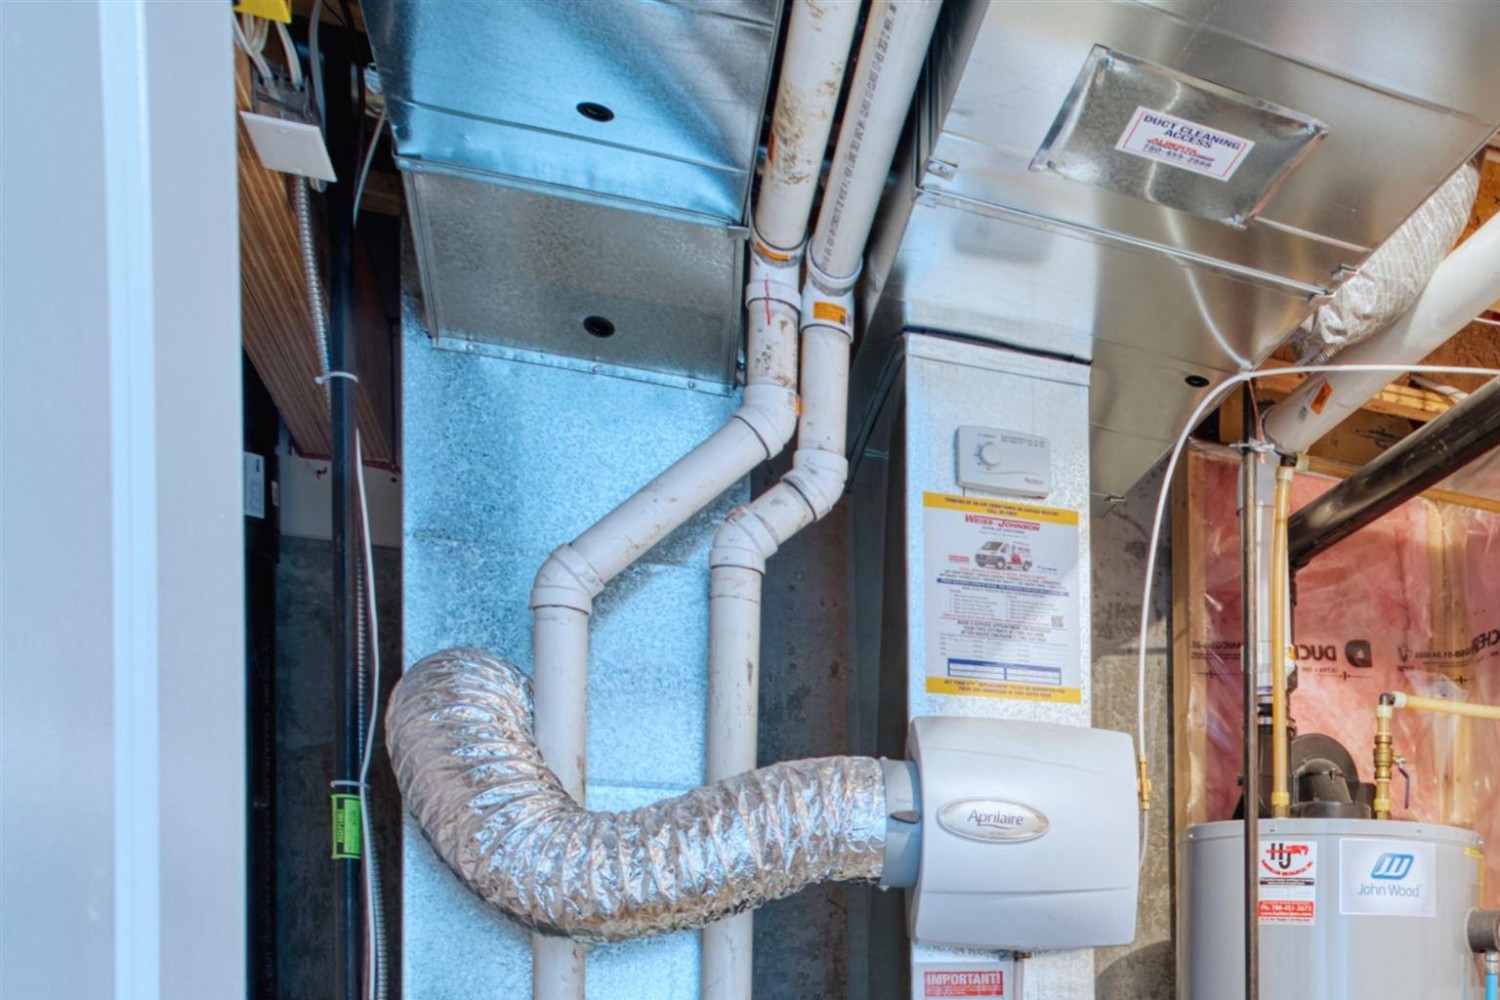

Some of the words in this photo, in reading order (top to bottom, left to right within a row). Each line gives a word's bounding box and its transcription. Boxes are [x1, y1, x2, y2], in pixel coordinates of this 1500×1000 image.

[1143, 115, 1177, 130] DUCT
[1179, 126, 1241, 151] CLEANING
[1164, 129, 1213, 149] ACCESS
[967, 808, 1024, 827] Aprilaire
[1357, 883, 1386, 896] John
[1389, 884, 1420, 898] Wood
[927, 972, 1001, 986] IMPORTANT!
